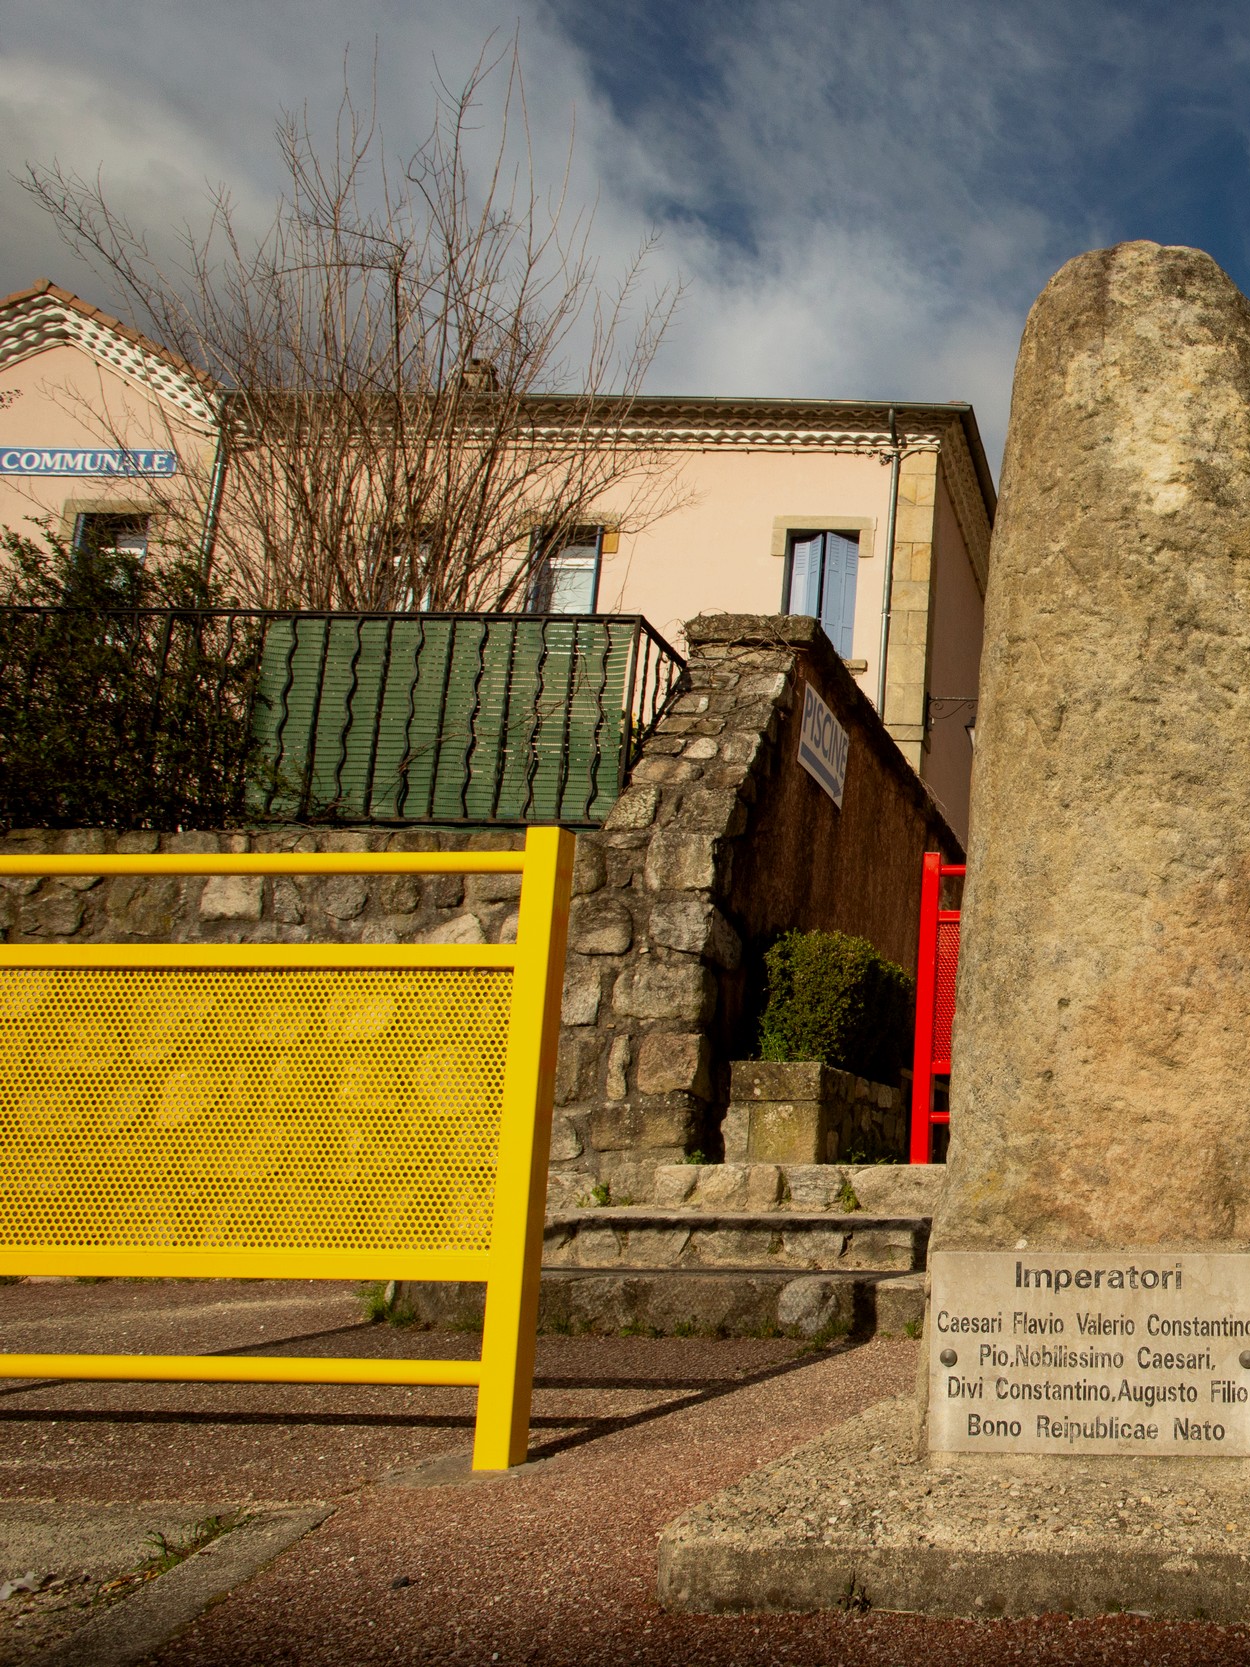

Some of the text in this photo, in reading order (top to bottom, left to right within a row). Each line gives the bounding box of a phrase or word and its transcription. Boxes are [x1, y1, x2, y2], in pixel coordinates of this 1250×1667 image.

[2, 451, 168, 472] COMMUNALE
[803, 688, 848, 777] PISCINE
[1015, 1260, 1183, 1294] Imperatori
[937, 1310, 1002, 1334] Caesari
[1013, 1311, 1065, 1335] Flavio
[1076, 1312, 1136, 1336] Valerio
[1137, 1346, 1216, 1371] Caesari,
[947, 1375, 984, 1400] Divi
[1210, 1380, 1249, 1404] Filio
[967, 1413, 1226, 1443] Bono Reipublicae Nato
